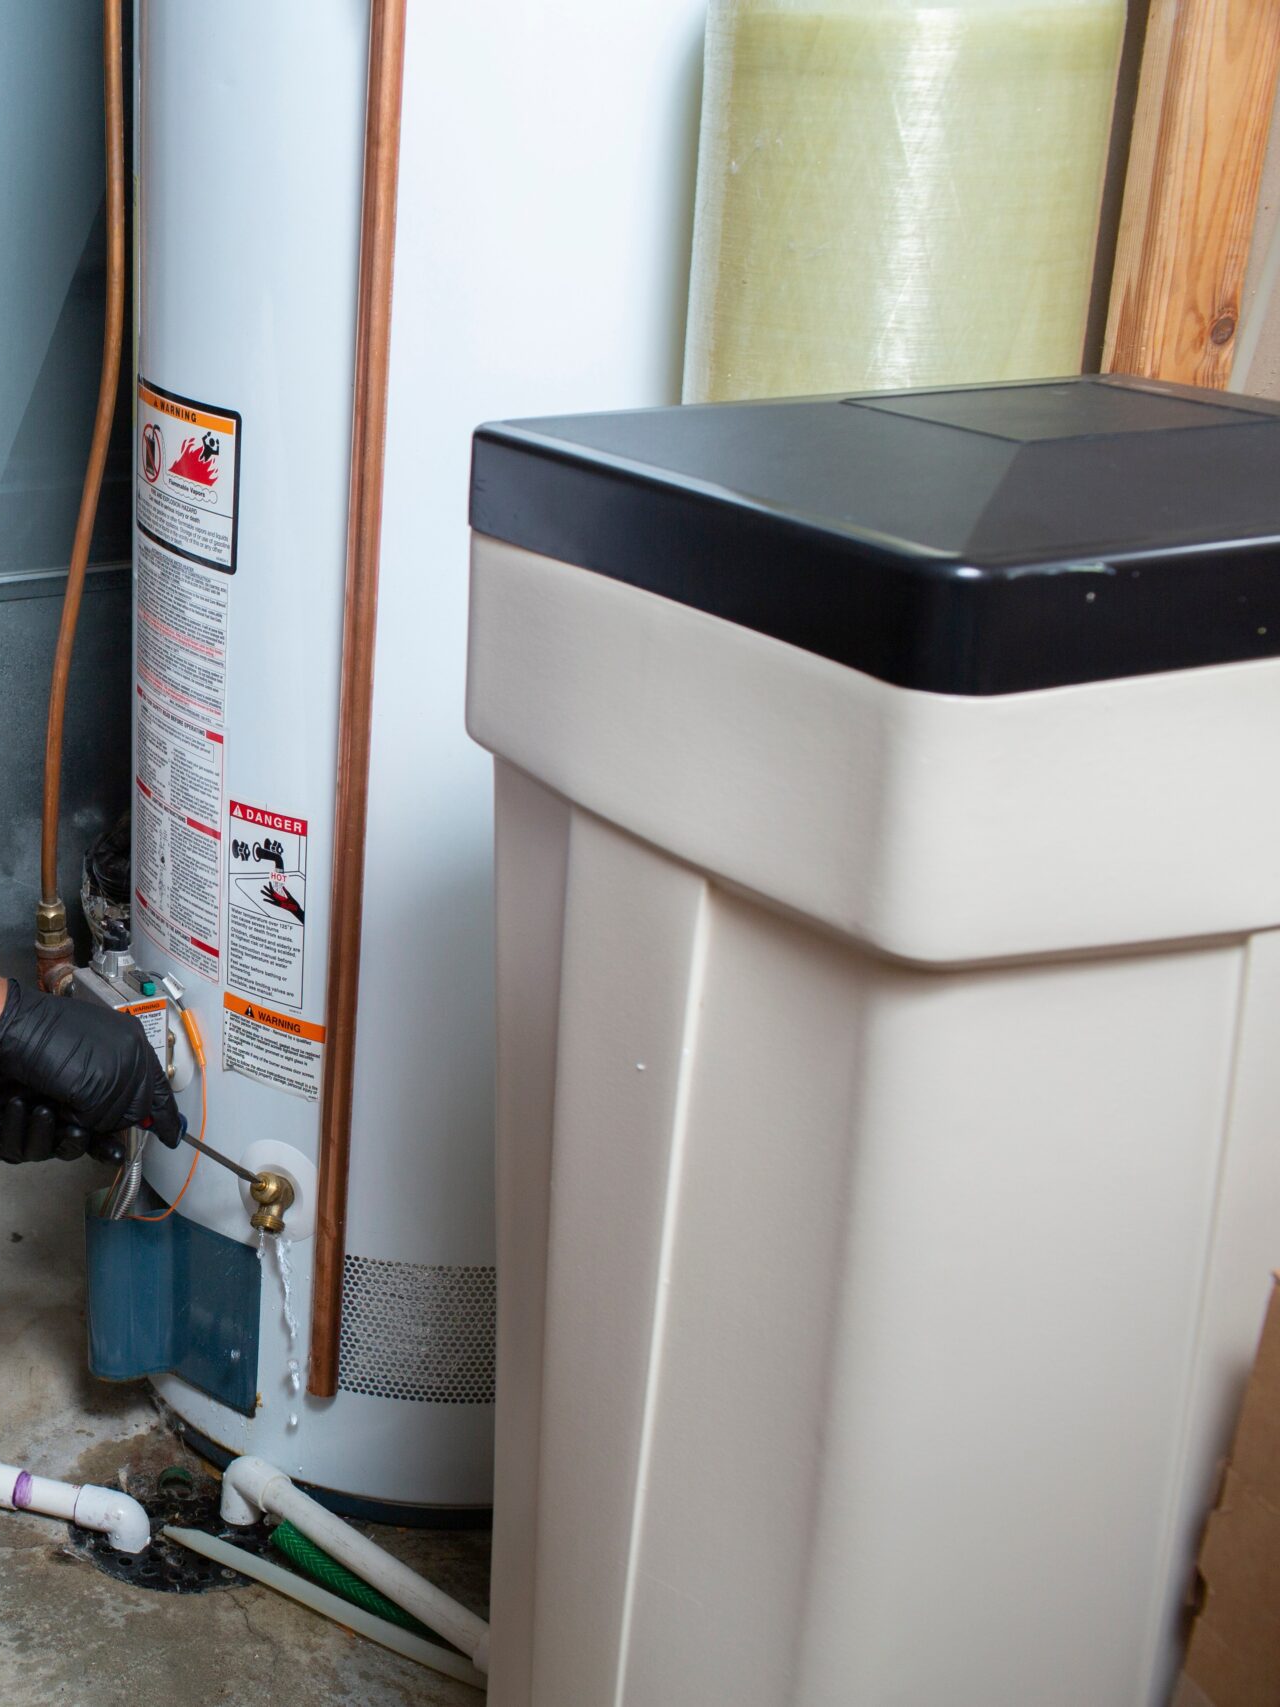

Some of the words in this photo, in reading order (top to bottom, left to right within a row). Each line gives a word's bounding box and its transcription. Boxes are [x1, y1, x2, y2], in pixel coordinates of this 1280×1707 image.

[160, 401, 197, 422] WARNING
[190, 488, 205, 497] Vapors
[246, 809, 302, 833] DANGER
[271, 872, 287, 882] HOT
[243, 911, 268, 924] temperature
[254, 926, 265, 934] death
[265, 943, 276, 952] being
[277, 943, 292, 951] elderly
[245, 951, 269, 963] temperature
[261, 951, 276, 959] manual
[278, 956, 292, 964] before
[251, 965, 264, 974] before
[265, 970, 281, 980] bathing
[133, 1004, 160, 1013] WARNING
[258, 1010, 300, 1033] WARNING
